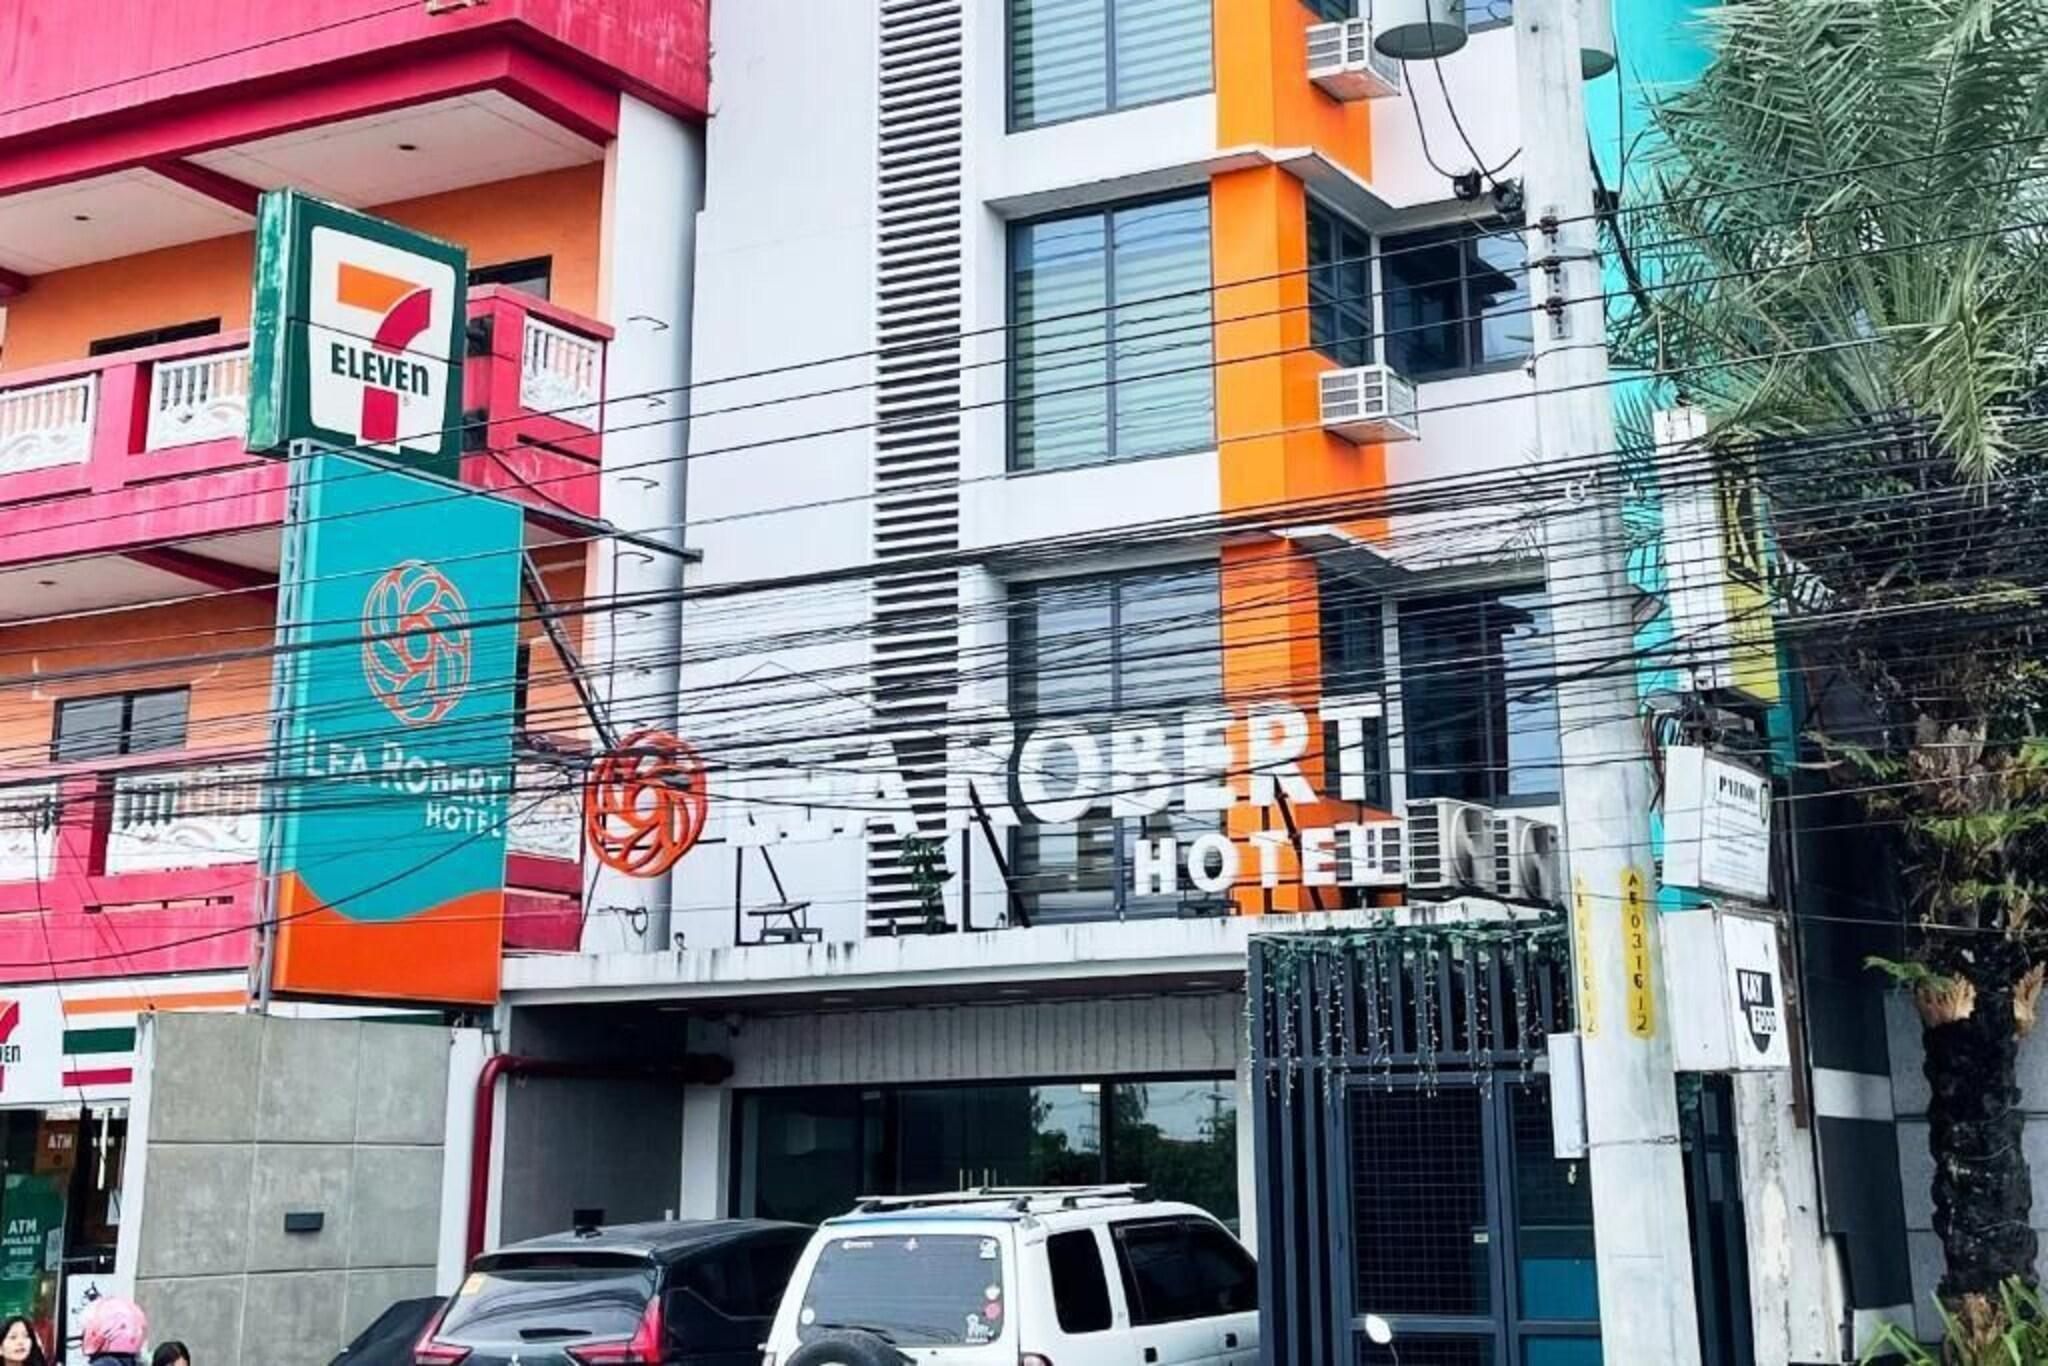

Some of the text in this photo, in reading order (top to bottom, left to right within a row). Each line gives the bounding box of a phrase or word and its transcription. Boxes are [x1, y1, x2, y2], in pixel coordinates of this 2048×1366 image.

[426, 799, 501, 838] HOTEL
[47, 1133, 73, 1149] ATM
[8, 1218, 37, 1234] ATM
